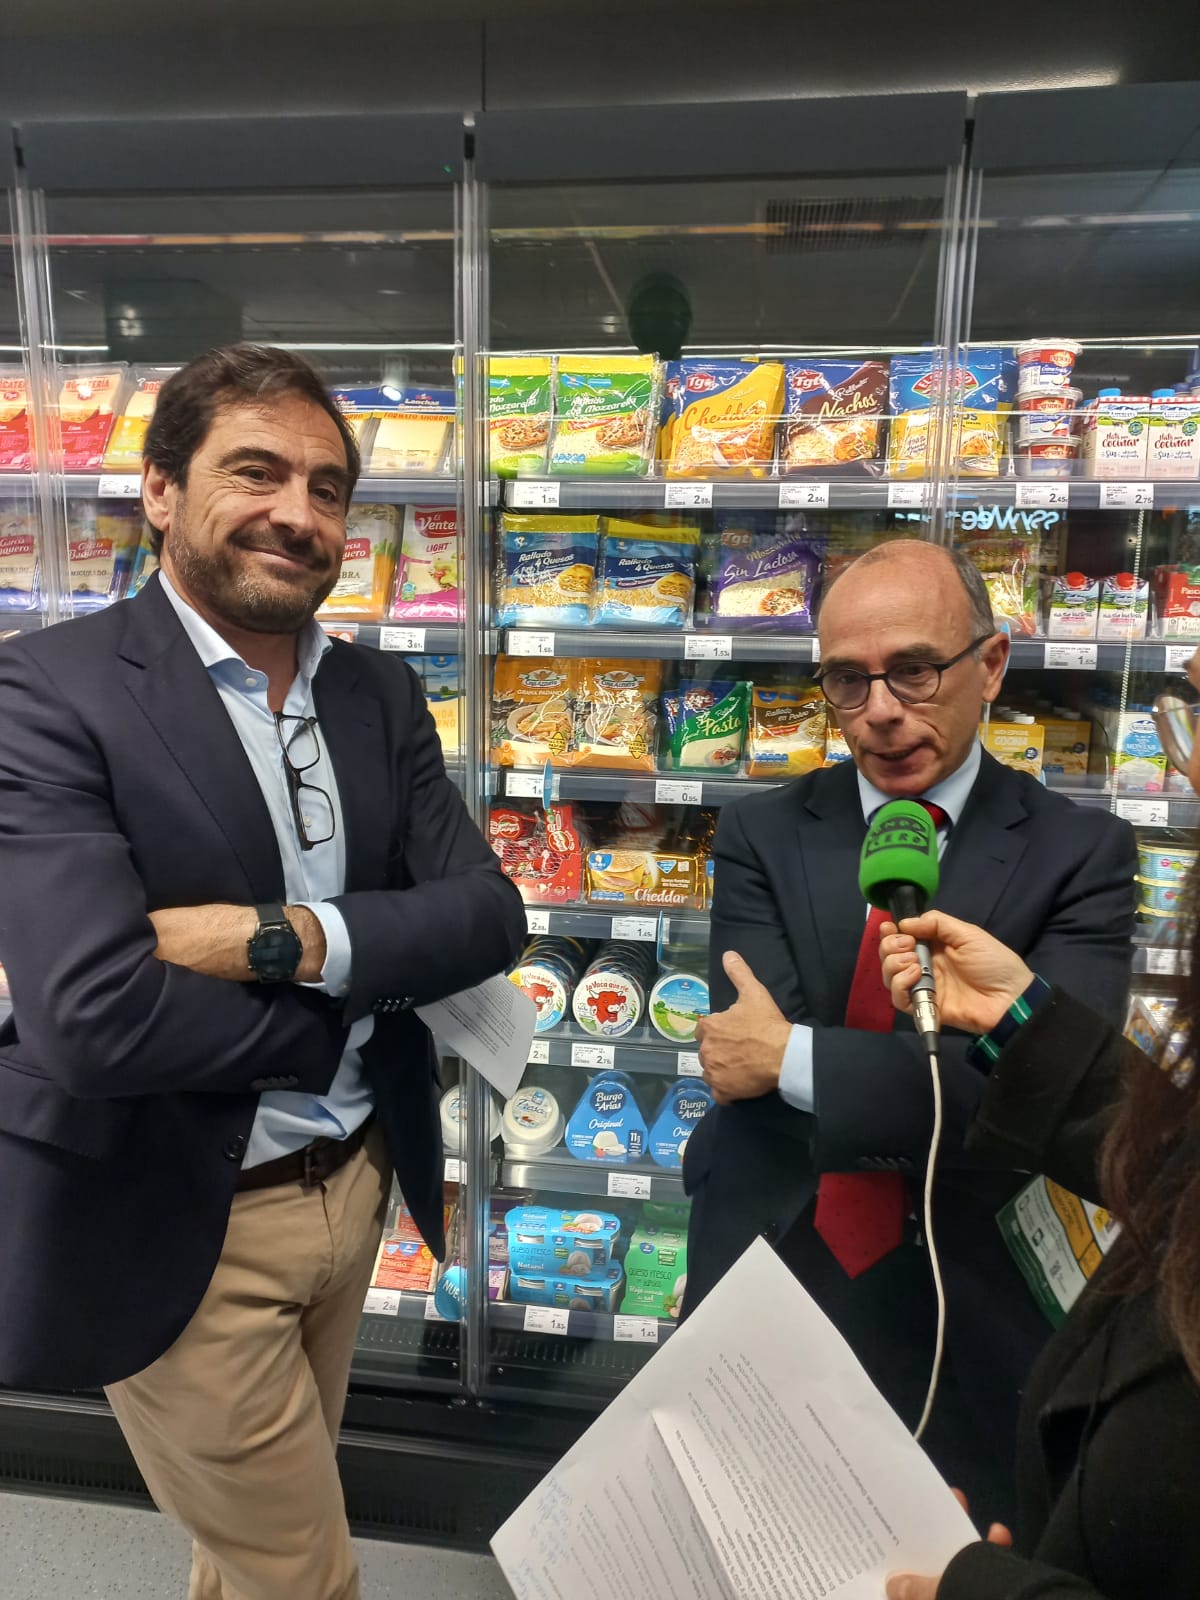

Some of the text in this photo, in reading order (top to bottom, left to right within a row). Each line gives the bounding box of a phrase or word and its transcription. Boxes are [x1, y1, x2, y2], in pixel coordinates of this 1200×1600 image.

[584, 397, 637, 414] Mozzarella
[818, 391, 878, 422] Nachos
[383, 412, 449, 421] FORMATO AHORRO
[722, 532, 750, 546] Tgt
[426, 542, 450, 553] LIGHT
[518, 550, 552, 562] Rallado
[535, 553, 575, 567] 4 Quesos
[618, 558, 653, 567] Rallado
[634, 562, 675, 572] 4 Quesos
[723, 550, 800, 584] Sin Lactosa
[765, 707, 792, 718] Rallado
[702, 717, 742, 737] Pasta
[634, 888, 689, 904] Cheddar
[592, 981, 607, 989] Vaca
[595, 1091, 623, 1102] Burgo
[597, 1101, 622, 1112] Arias
[678, 1099, 707, 1110] Burgo
[680, 1109, 705, 1120] Arias
[588, 1118, 624, 1130] Original
[517, 1262, 545, 1270] Natural
